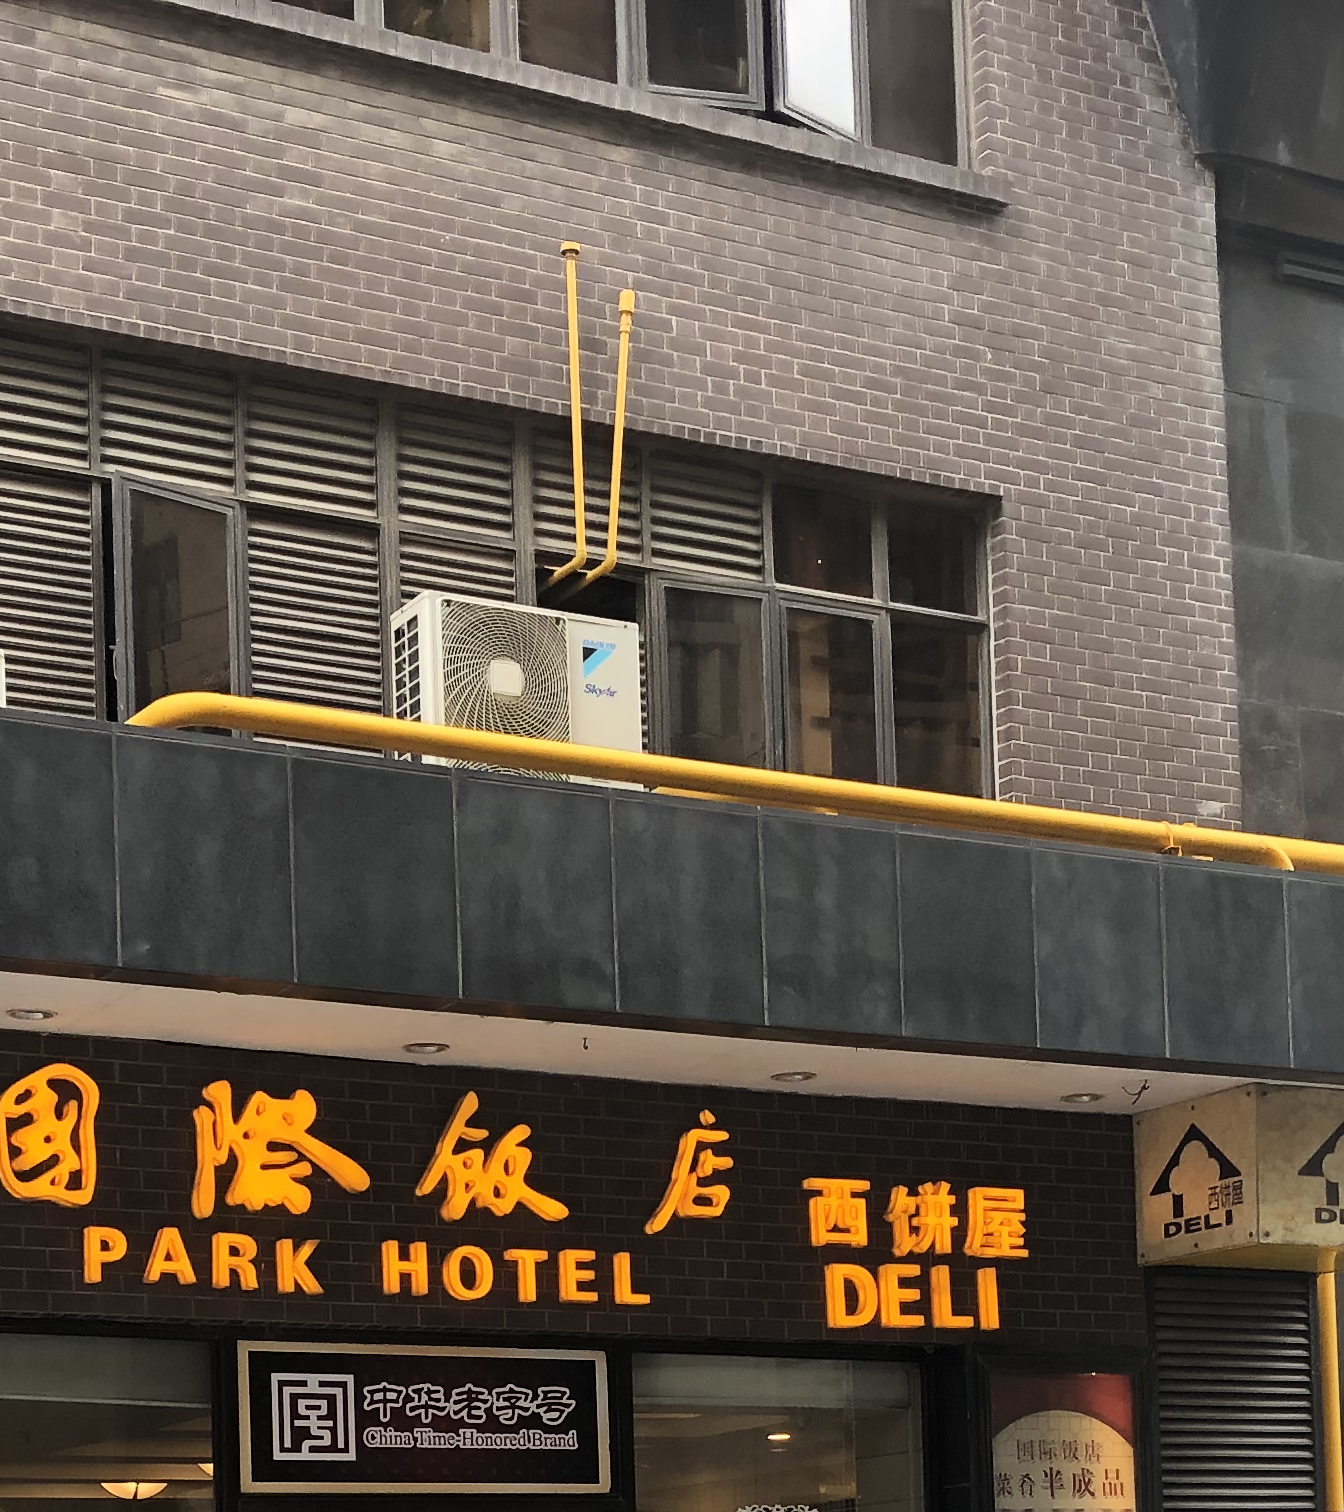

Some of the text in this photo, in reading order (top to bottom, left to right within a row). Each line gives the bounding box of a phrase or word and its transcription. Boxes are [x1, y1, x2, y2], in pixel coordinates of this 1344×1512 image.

[802, 1177, 1029, 1259] 西饼屋
[1163, 1209, 1234, 1239] DELI
[82, 1225, 651, 1306] PARK HOTEL
[824, 1263, 1000, 1331] DELI
[363, 1381, 577, 1426] 中华老字号
[363, 1428, 579, 1450] China Time-Honored Brand
[1016, 1438, 1104, 1465] 国际饭店
